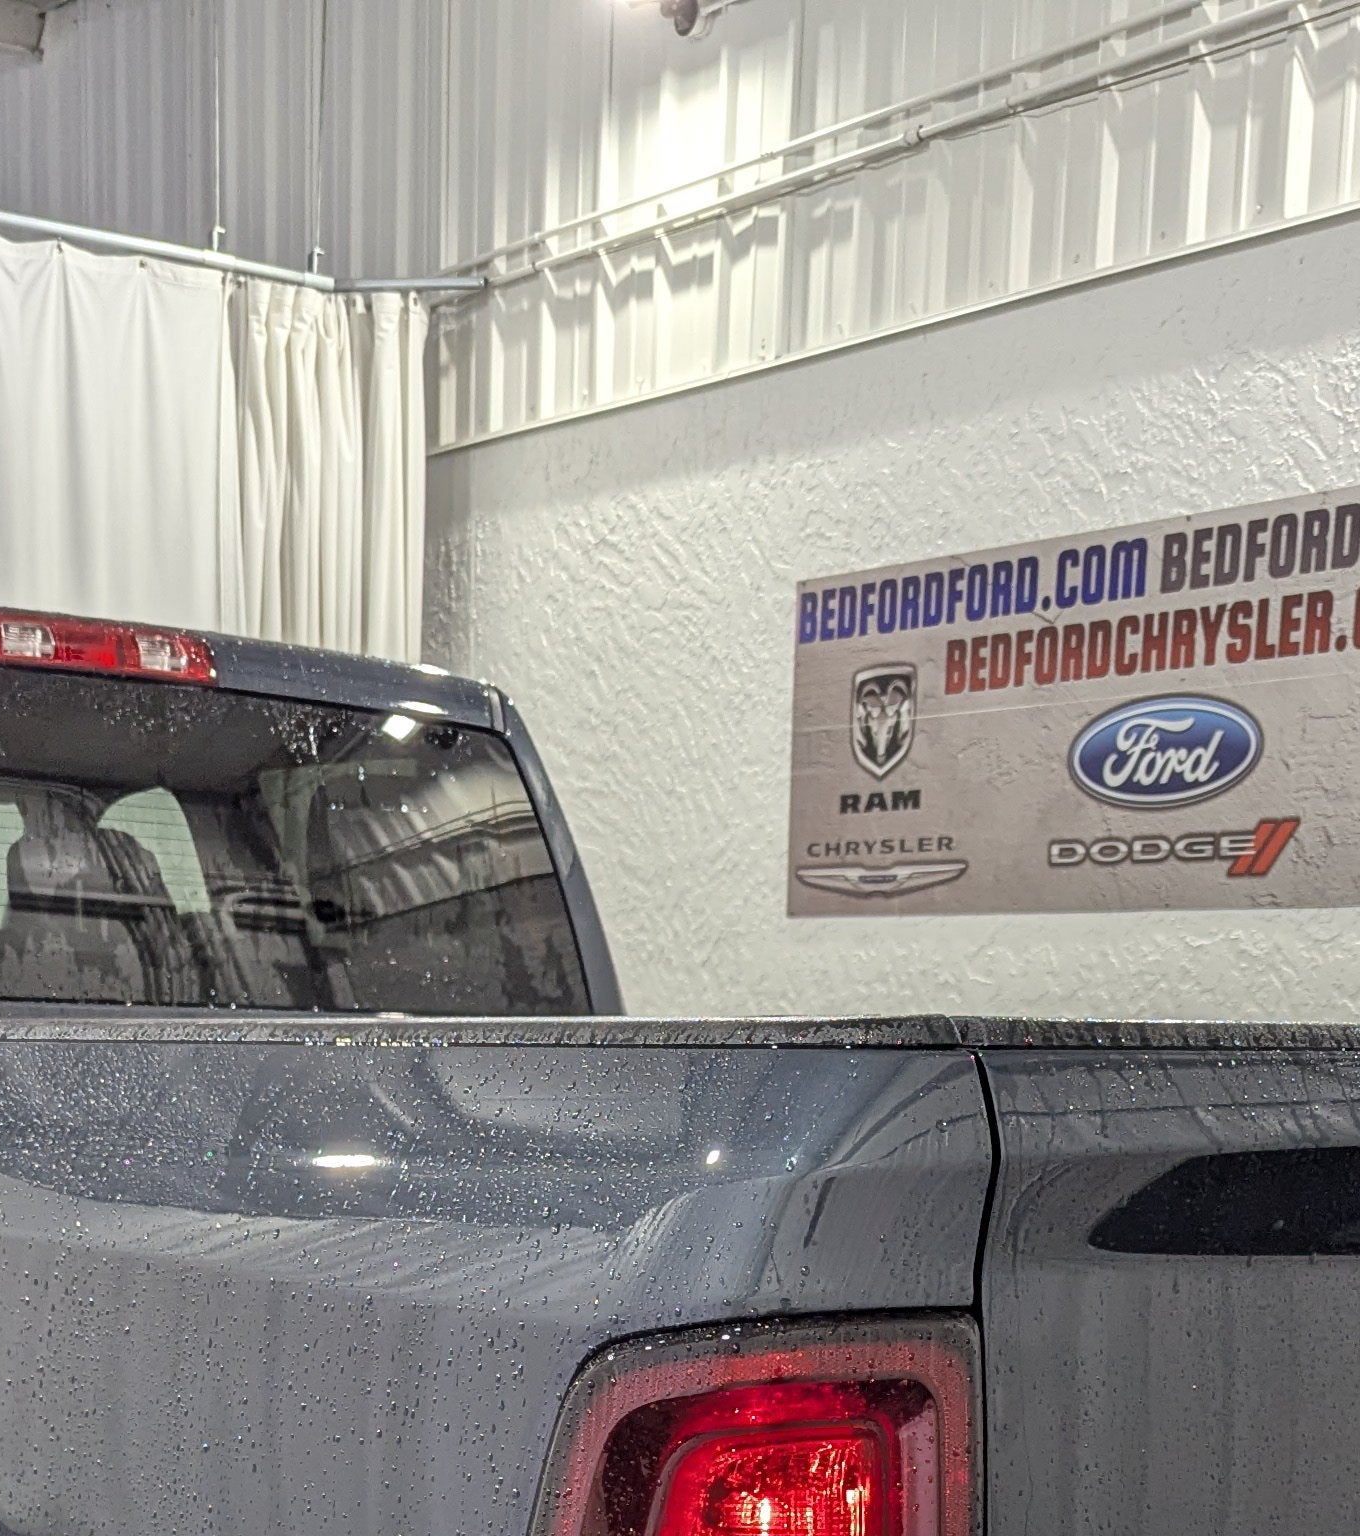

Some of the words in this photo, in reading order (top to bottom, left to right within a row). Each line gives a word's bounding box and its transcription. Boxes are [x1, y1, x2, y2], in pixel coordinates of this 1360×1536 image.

[798, 537, 1148, 644] BEDFORDFORD.COM
[1103, 717, 1225, 788] Ford
[840, 789, 921, 814] RAM
[806, 836, 955, 858] CHRYSLER
[1049, 830, 1260, 867] DODGE
